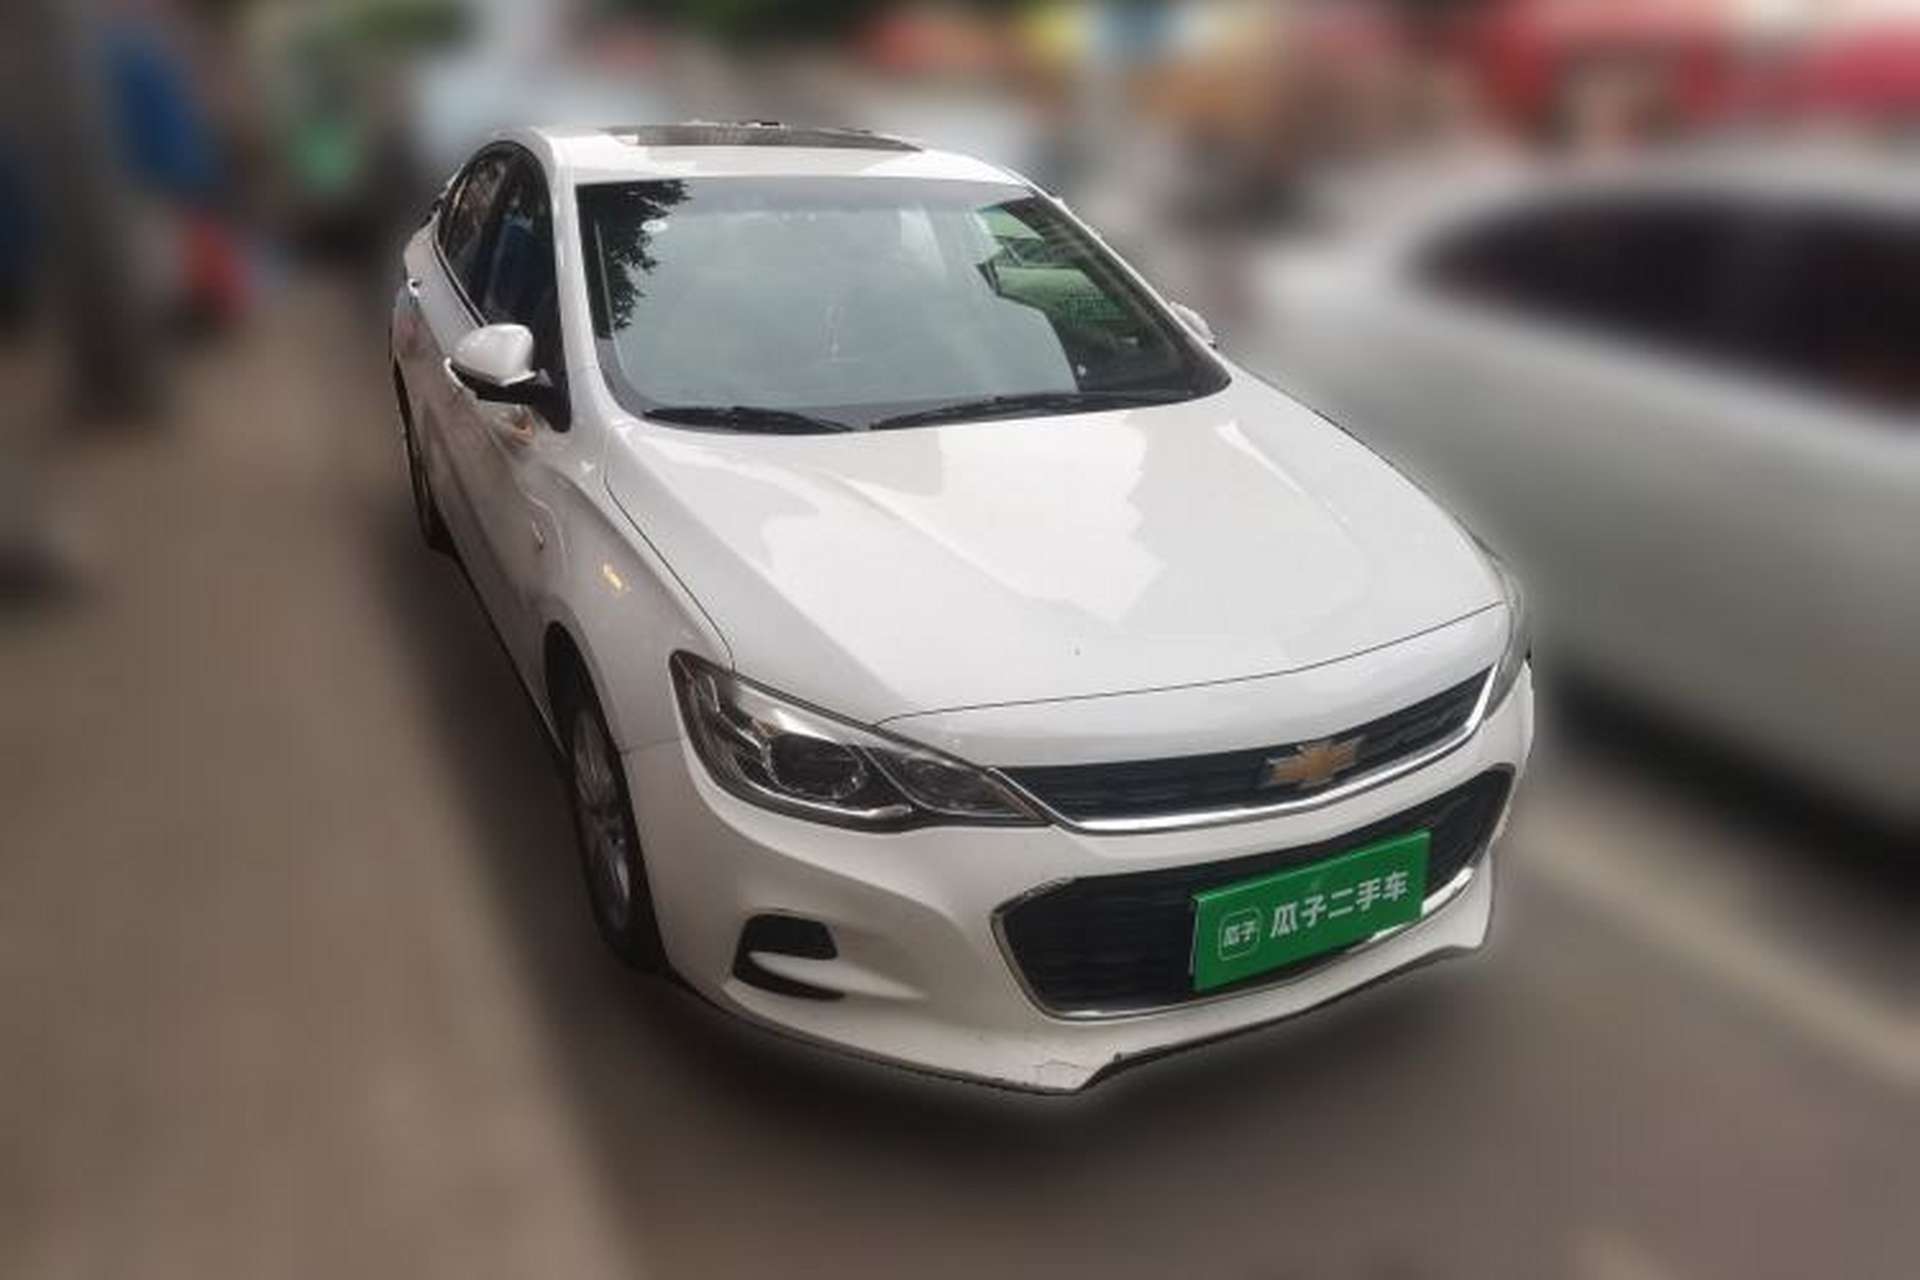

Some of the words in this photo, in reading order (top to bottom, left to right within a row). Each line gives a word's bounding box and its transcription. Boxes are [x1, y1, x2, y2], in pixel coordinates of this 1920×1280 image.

[1223, 921, 1256, 946] 瓜子
[1270, 871, 1408, 938] 瓜子二手车
